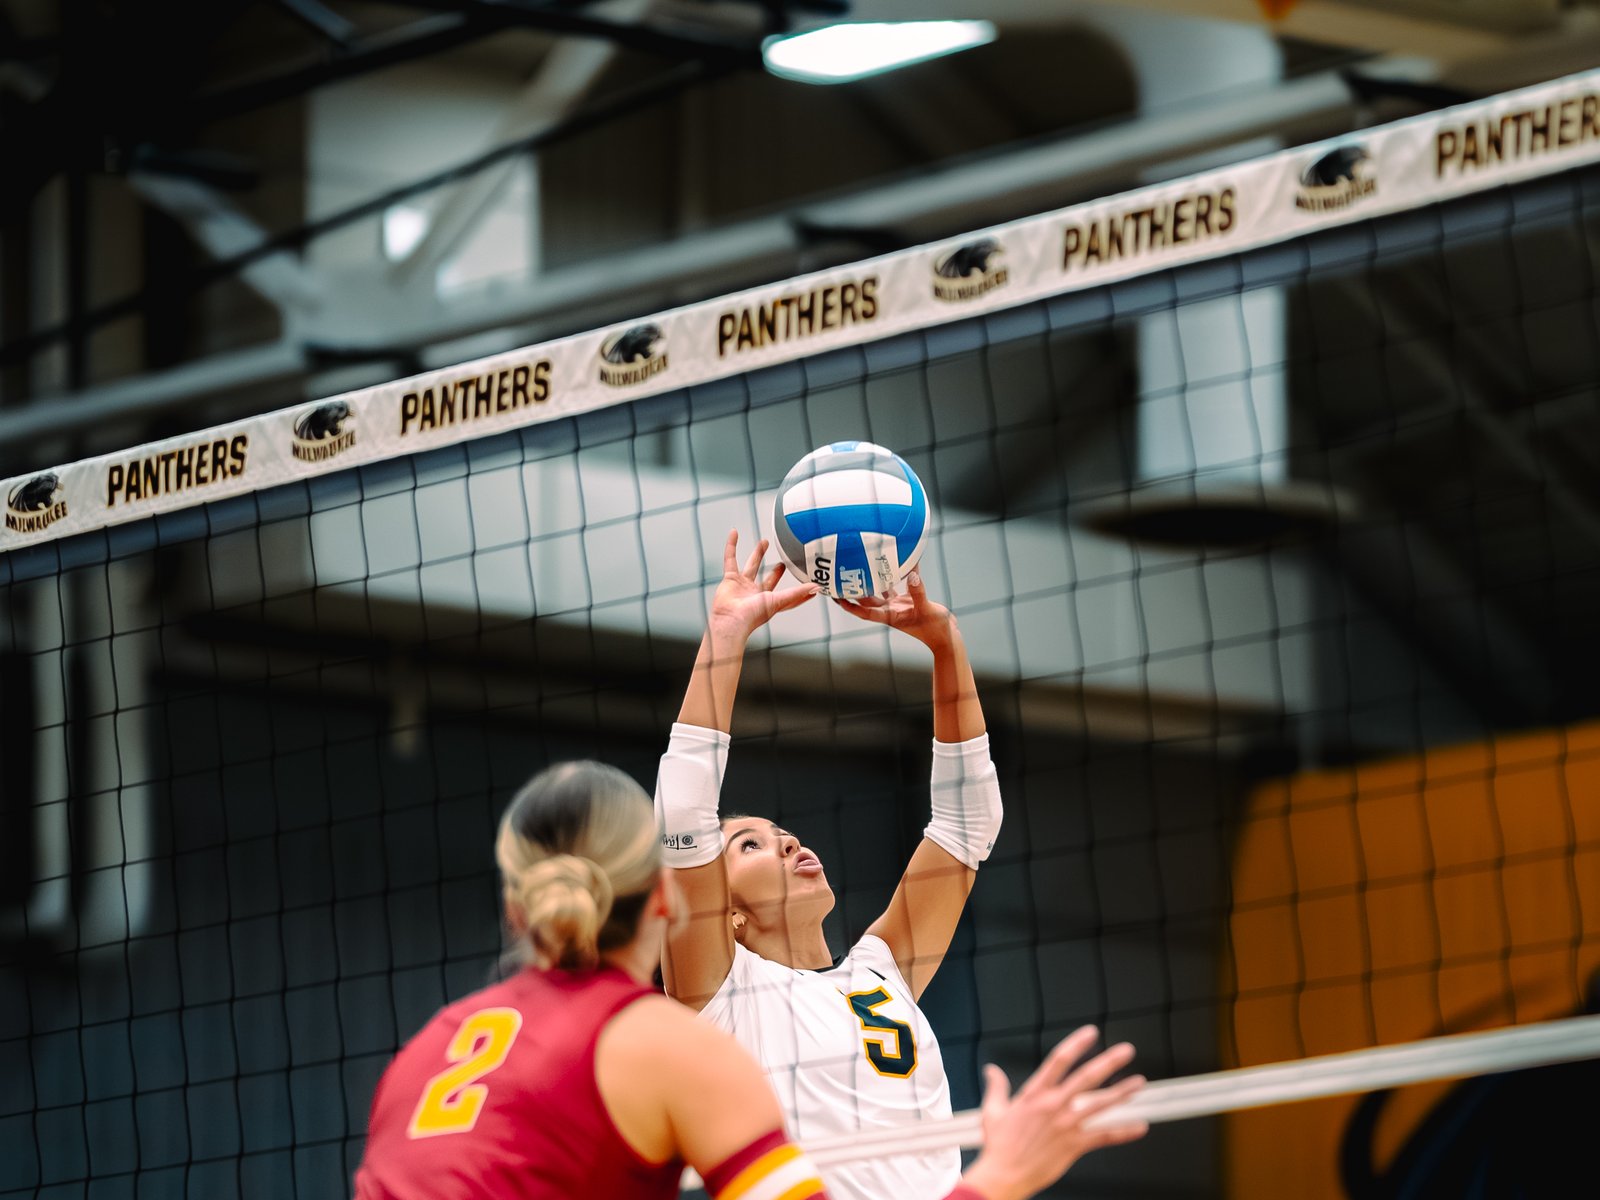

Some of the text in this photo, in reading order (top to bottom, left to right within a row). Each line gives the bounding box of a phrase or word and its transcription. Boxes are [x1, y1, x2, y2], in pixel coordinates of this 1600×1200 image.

[1061, 187, 1235, 272] PANTHERS
[717, 277, 879, 358] PANTHERS
[400, 360, 551, 438] PANTHERS
[107, 435, 249, 508] PANTHERS
[5, 500, 69, 534] MILWAUKEE
[846, 985, 918, 1079] 5
[406, 1006, 524, 1140] 2
